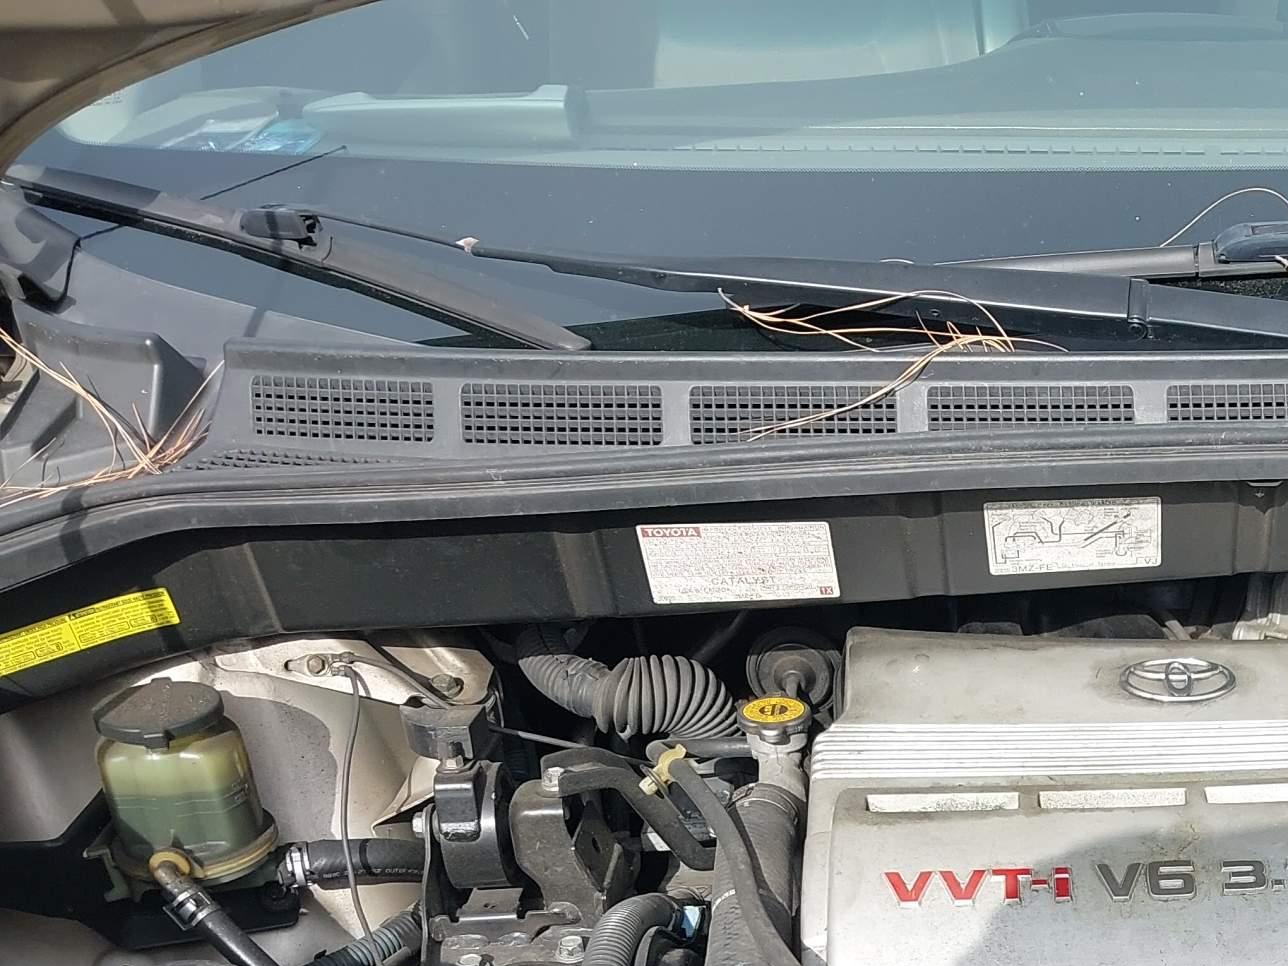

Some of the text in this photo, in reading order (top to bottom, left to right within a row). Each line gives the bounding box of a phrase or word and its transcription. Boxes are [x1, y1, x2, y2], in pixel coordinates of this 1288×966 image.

[645, 527, 698, 538] TOYOTA
[711, 576, 776, 587] CATALYST
[883, 867, 1073, 907] VVT-i
[1096, 859, 1196, 902] V6
